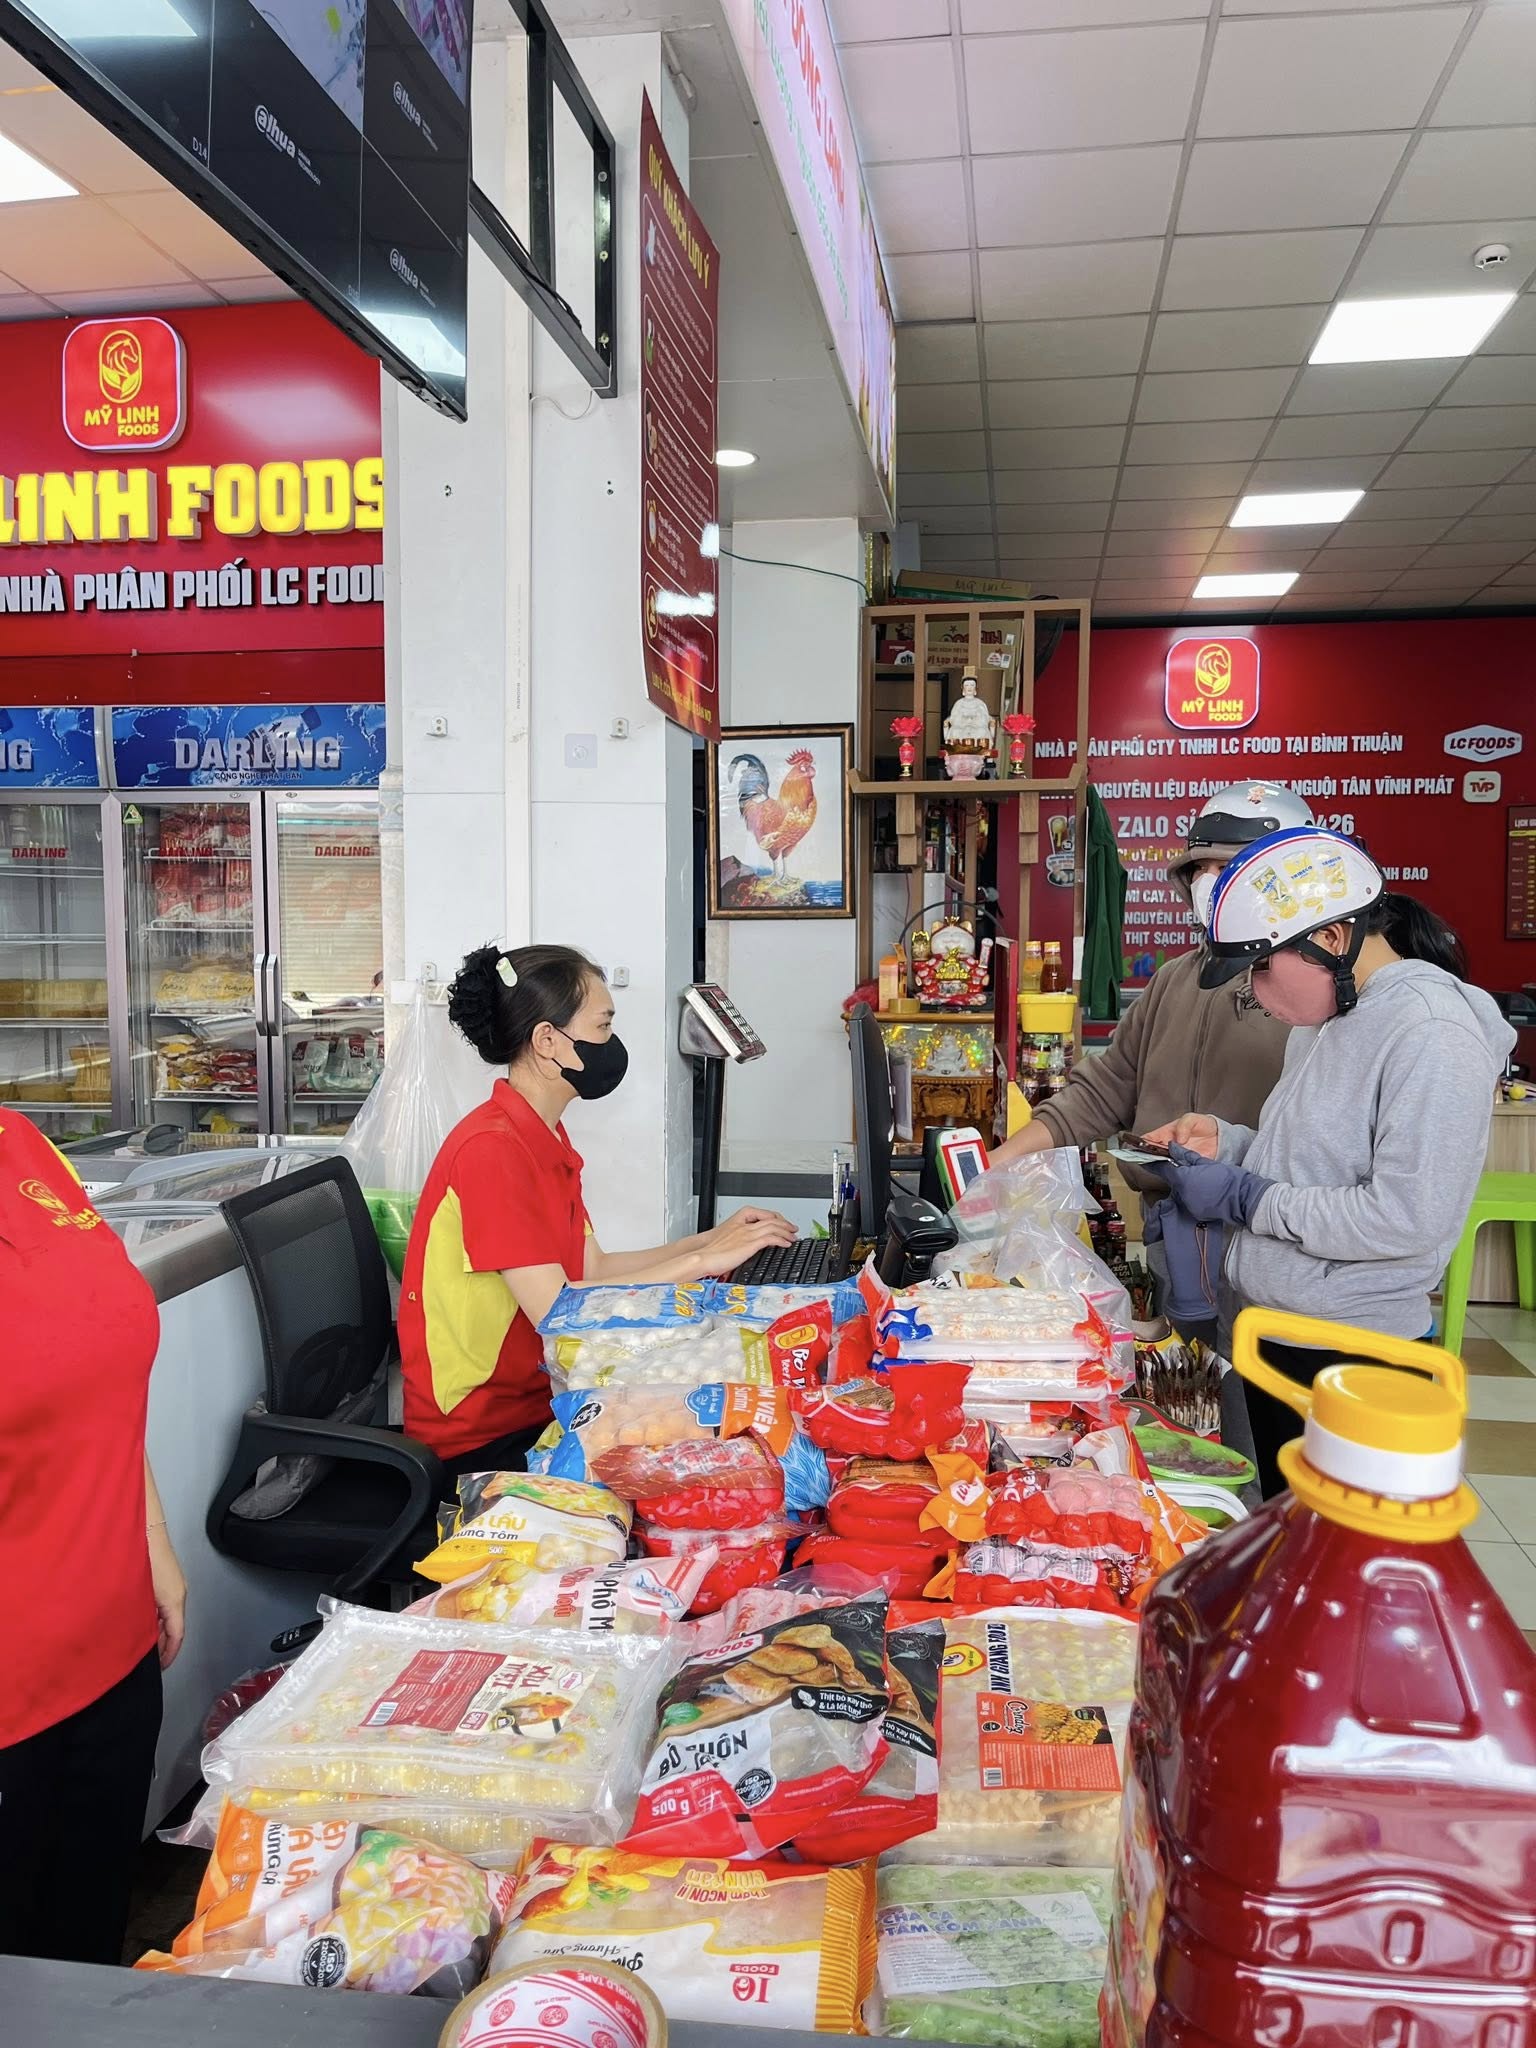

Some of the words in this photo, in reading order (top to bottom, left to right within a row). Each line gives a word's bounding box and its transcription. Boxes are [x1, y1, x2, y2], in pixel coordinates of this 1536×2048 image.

[84, 404, 112, 426] MỸ
[117, 406, 159, 423] LINH
[118, 423, 159, 436] FOODS
[0, 568, 65, 612] NHÀ
[74, 565, 165, 610] PHÂN
[173, 557, 252, 608] PHỐI
[261, 567, 299, 606] LC
[1182, 697, 1205, 713] MỸ
[1208, 700, 1243, 712] LINH
[1209, 712, 1242, 721] FOODS
[176, 737, 341, 769] DARLING
[1035, 738, 1065, 758] NHÀ
[1068, 737, 1109, 757] PÂN
[1111, 734, 1144, 756] PHỐI
[1147, 739, 1175, 755] CTY
[1179, 738, 1217, 755] TNHH
[1221, 737, 1239, 754] LC
[1243, 736, 1281, 754] FOOD
[1285, 736, 1308, 756] TẠI
[1311, 733, 1348, 753] BÌNH
[1352, 732, 1403, 755] THUẬN
[1094, 778, 1152, 799] NGUYÊN
[1155, 778, 1185, 800] LIỆU
[1291, 776, 1337, 799] NGUỘI
[1341, 776, 1370, 795] TÂN
[1375, 775, 1411, 795] VĨNH
[1415, 775, 1454, 794] PHÁT
[1469, 782, 1495, 793] TVP
[1118, 816, 1168, 837] ZALO
[12, 847, 67, 859] DARLING
[315, 846, 371, 857] DARLING
[1126, 866, 1152, 881] XIÊN
[1403, 867, 1428, 880] BAO
[1124, 909, 1175, 925] NGUYÊN
[1125, 931, 1150, 946] THỊT
[1154, 932, 1185, 946] SẠCH
[705, 1638, 754, 1657] OODS
[820, 1692, 835, 1701] Thịt
[1006, 1700, 1031, 1735] Corndog
[659, 1743, 681, 1779] BÒ
[652, 1798, 676, 1816] 500
[681, 1799, 690, 1815] g
[267, 1822, 285, 1869] RỨNG
[326, 1952, 335, 1972] ISO
[735, 1964, 776, 1974] FOODS
[577, 1972, 604, 1988] TAPE
